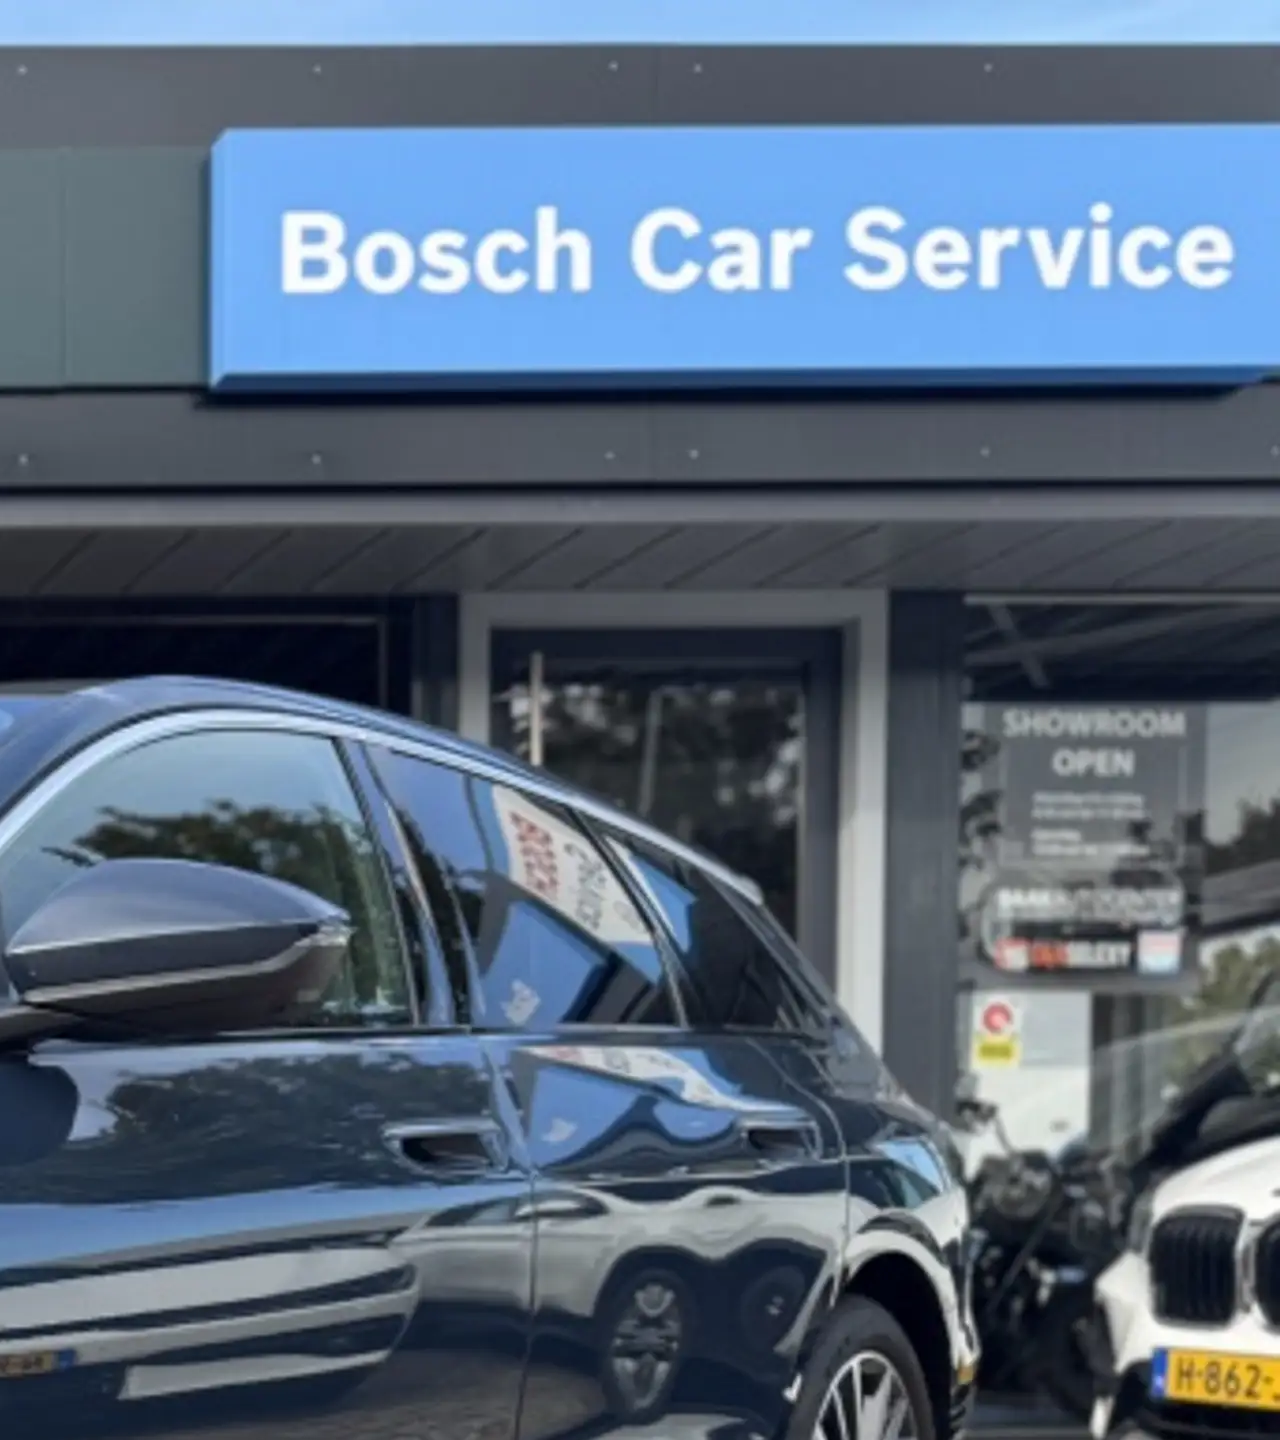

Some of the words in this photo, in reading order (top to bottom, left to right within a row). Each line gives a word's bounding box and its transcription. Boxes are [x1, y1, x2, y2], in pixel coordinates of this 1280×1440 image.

[281, 205, 592, 295] Bosch
[630, 207, 814, 292] Car
[843, 201, 1235, 291] Service
[1002, 709, 1187, 738] SHOWROOM
[1051, 748, 1136, 778] OPEN
[1176, 1354, 1280, 1402] H-862-
